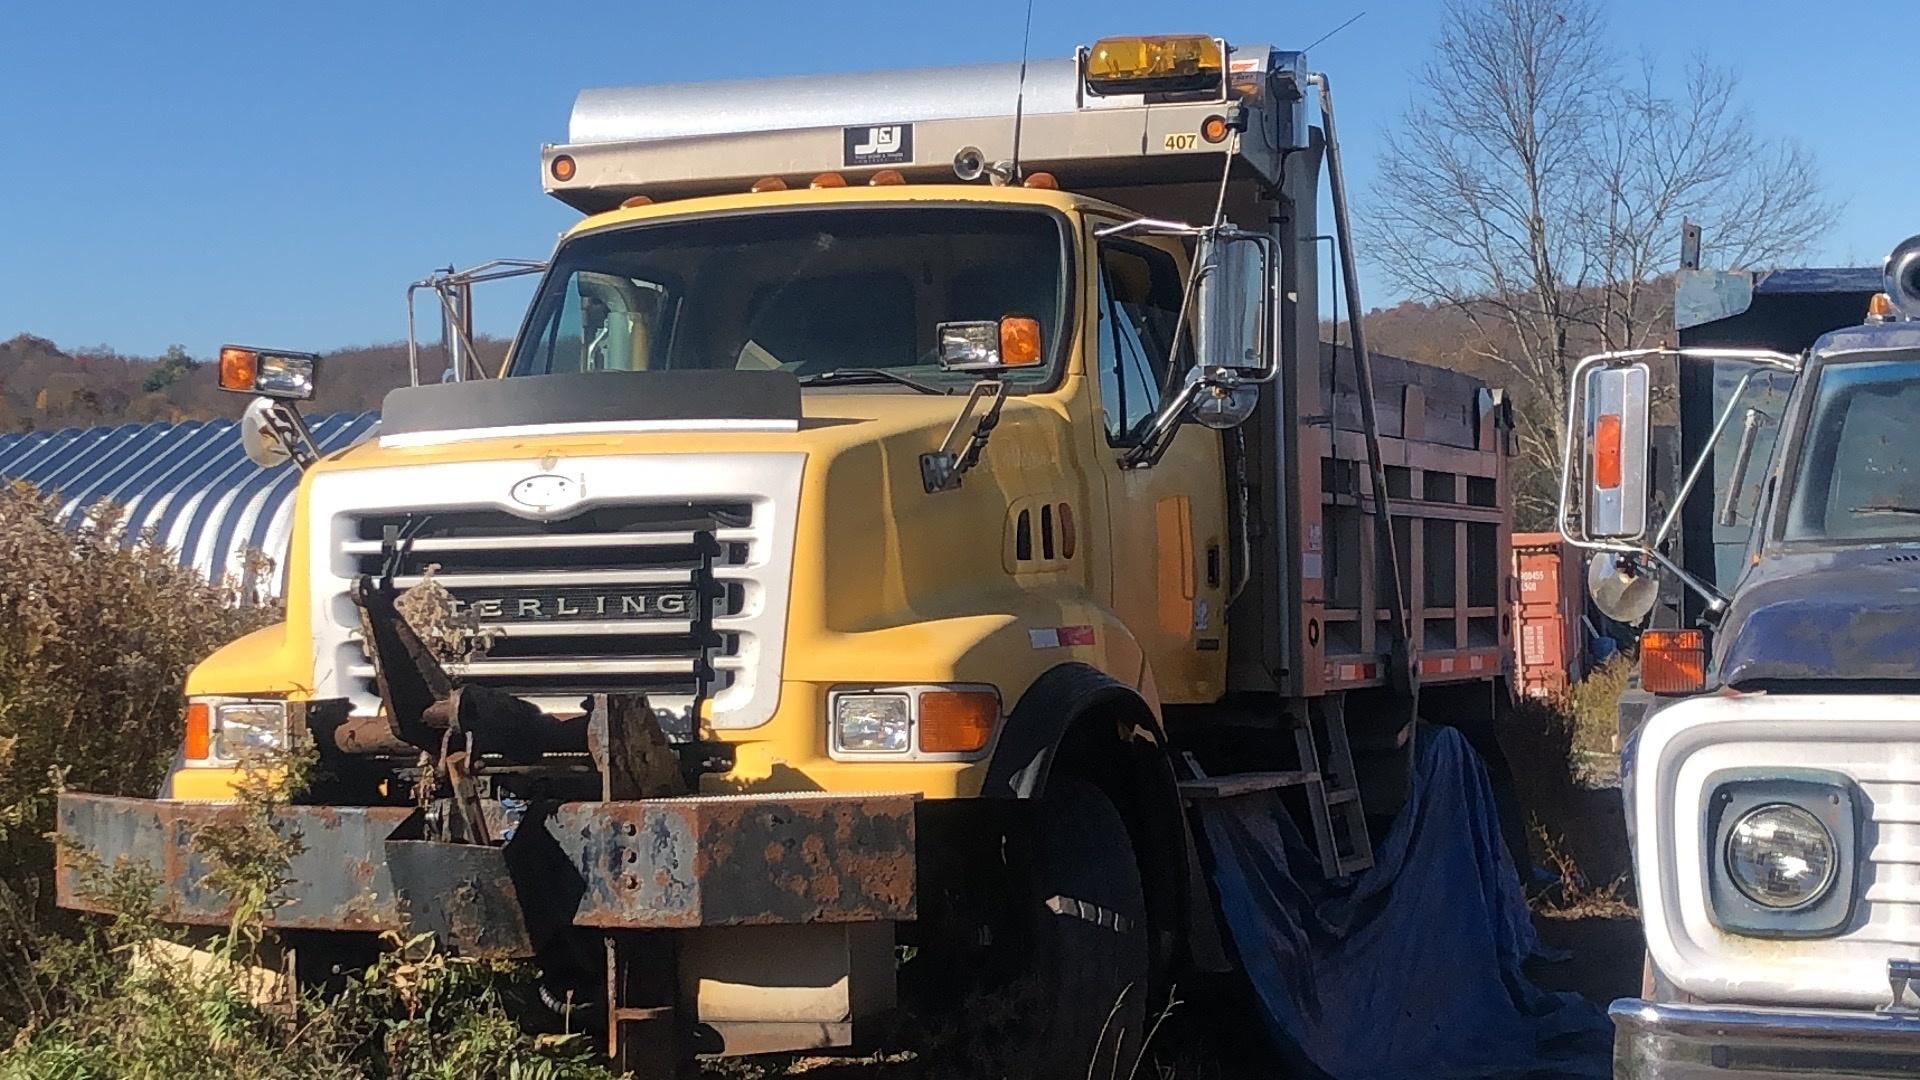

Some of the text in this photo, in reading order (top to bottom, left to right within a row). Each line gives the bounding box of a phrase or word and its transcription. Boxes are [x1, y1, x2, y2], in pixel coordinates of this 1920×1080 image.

[854, 126, 902, 155] J&J
[1165, 134, 1197, 150] 407
[448, 594, 685, 617] TERLING
